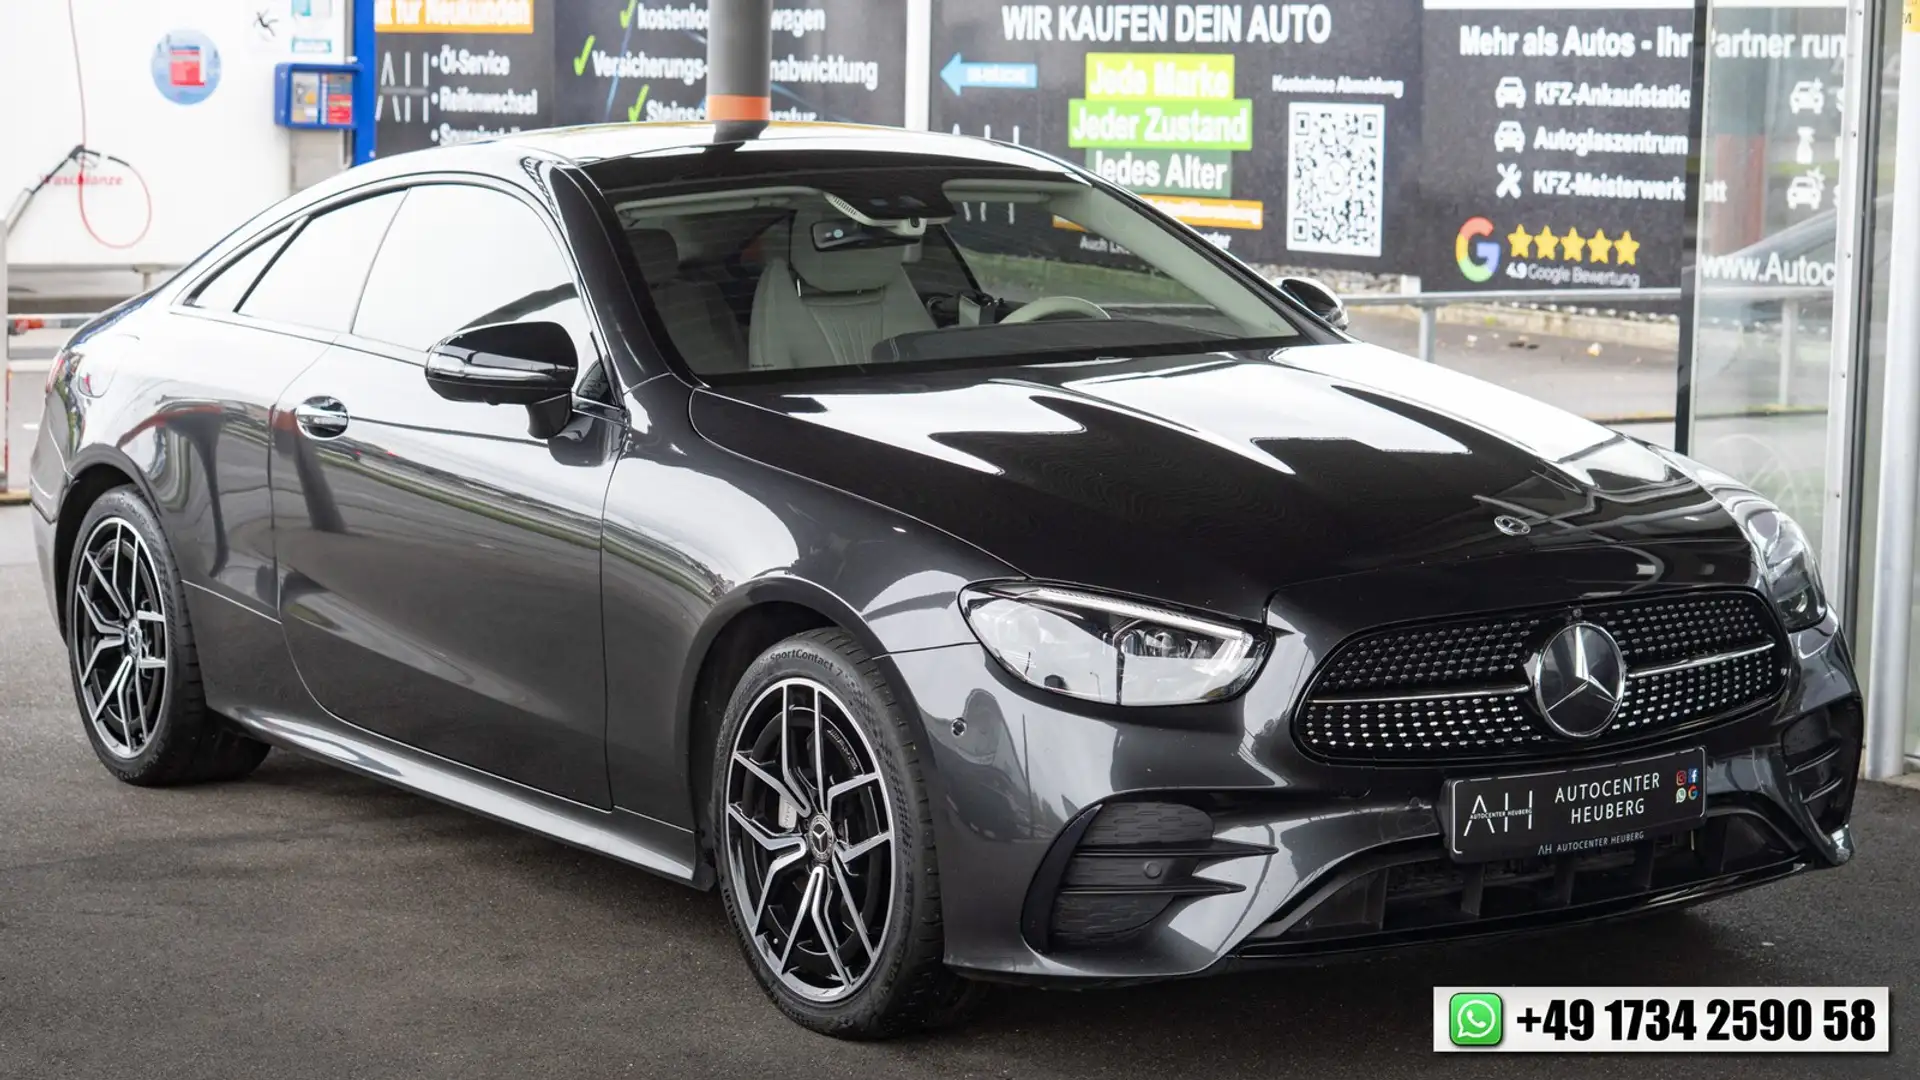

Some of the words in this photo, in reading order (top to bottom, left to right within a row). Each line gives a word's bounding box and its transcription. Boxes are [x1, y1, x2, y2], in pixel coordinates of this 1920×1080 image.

[1001, 6, 1052, 41] WIR
[1058, 6, 1168, 42] KAUFEN
[1174, 5, 1246, 43] DEIN
[1247, 5, 1332, 43] AUTO
[1460, 26, 1519, 56] Mehr
[1523, 26, 1558, 57] als
[1562, 27, 1635, 57] Autos
[1657, 27, 1692, 58] Ihr
[1802, 33, 1846, 58] run
[440, 44, 510, 75] Öl-Service
[769, 54, 878, 91] nabwicklung
[1089, 61, 1147, 95] Jede
[1153, 61, 1229, 97] Marke
[1535, 80, 1691, 108] KFZ-Ankaufstatio
[440, 86, 537, 115] Reifenwechsel
[1072, 106, 1140, 140] Jeder
[1144, 106, 1248, 142] Zustand
[1533, 126, 1689, 157] Autoglaszentrum
[1092, 150, 1160, 187] Jedes
[1164, 153, 1228, 190] Alter
[1527, 263, 1571, 285] Google
[1700, 252, 1835, 286] www.Autoc
[770, 648, 834, 672] SportContact
[1554, 772, 1660, 804] AUTOCENTER
[1470, 811, 1506, 820] AUTOCENTER
[1507, 808, 1533, 817] HEUBERG
[1570, 798, 1645, 825] HEUBERG
[1556, 837, 1608, 852] AUTOCENTER
[1610, 831, 1645, 845] HEUBERG
